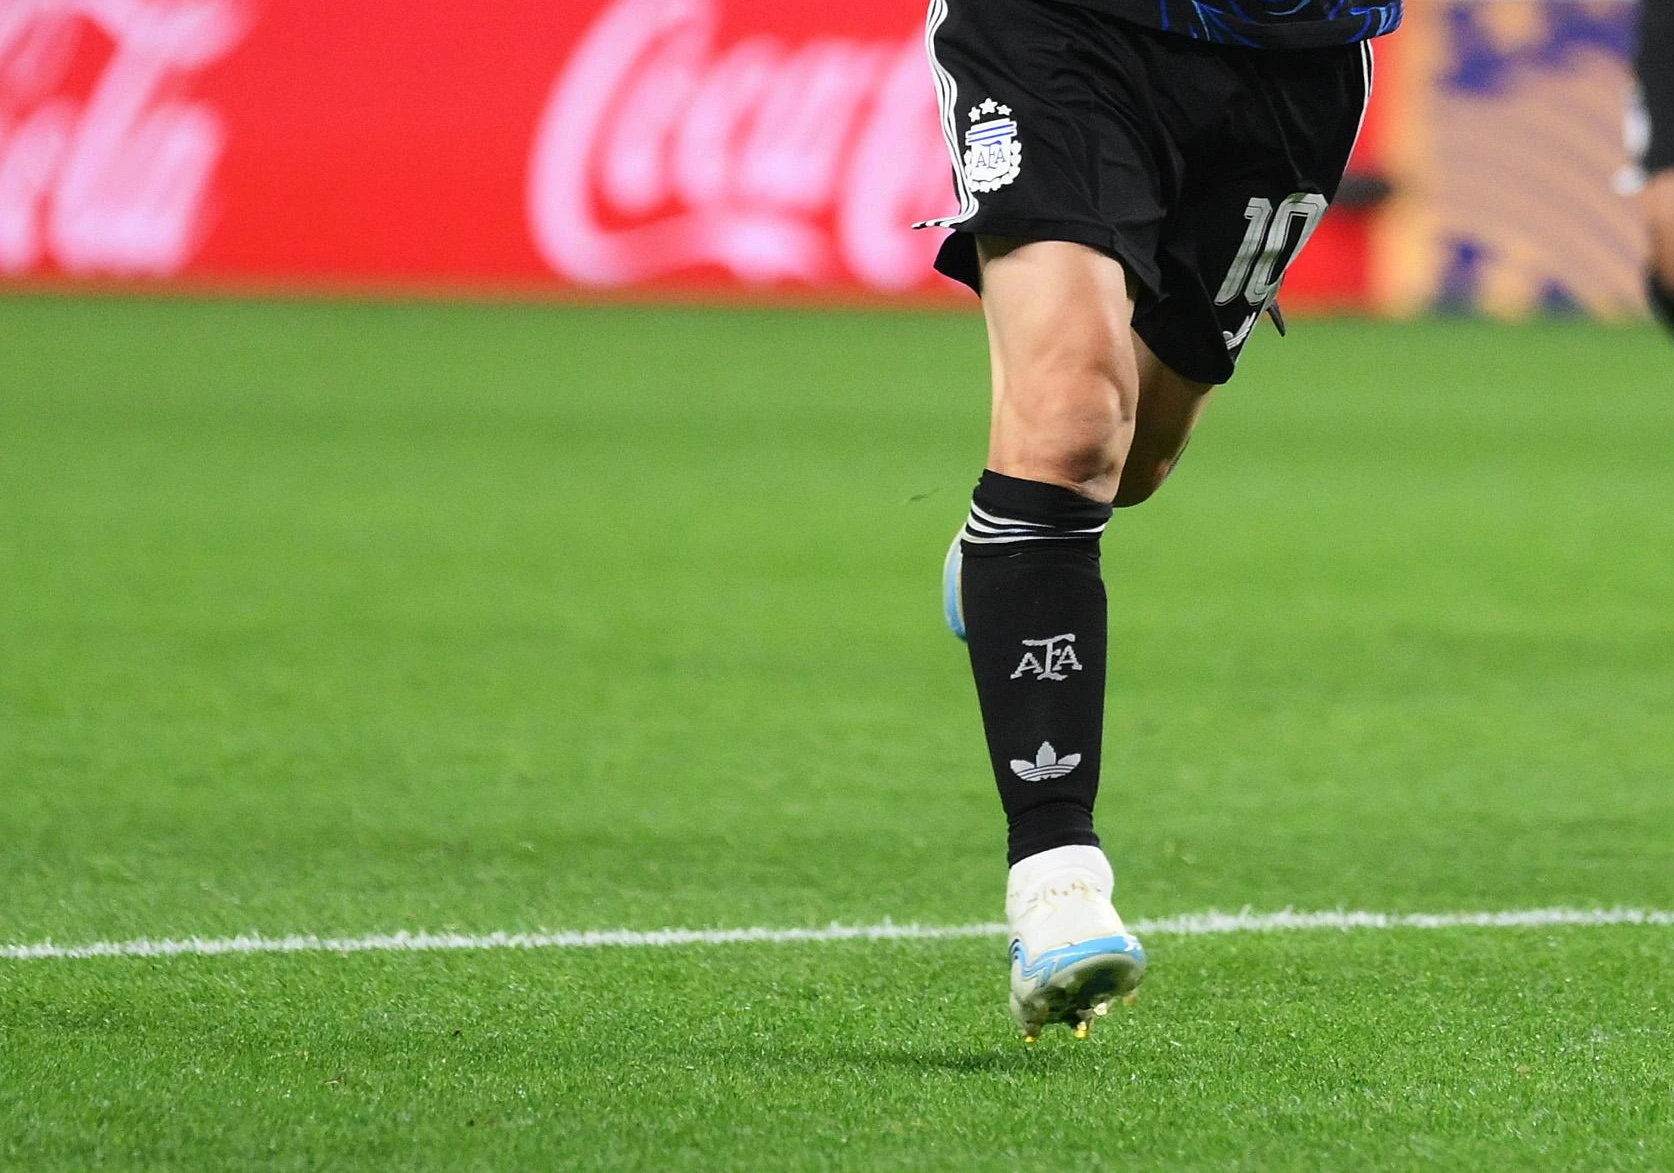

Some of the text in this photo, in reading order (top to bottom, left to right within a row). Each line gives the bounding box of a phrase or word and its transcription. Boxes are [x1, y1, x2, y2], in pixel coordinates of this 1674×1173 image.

[975, 140, 1006, 170] AFA
[1214, 193, 1329, 306] 10
[1010, 633, 1082, 681] AFA
